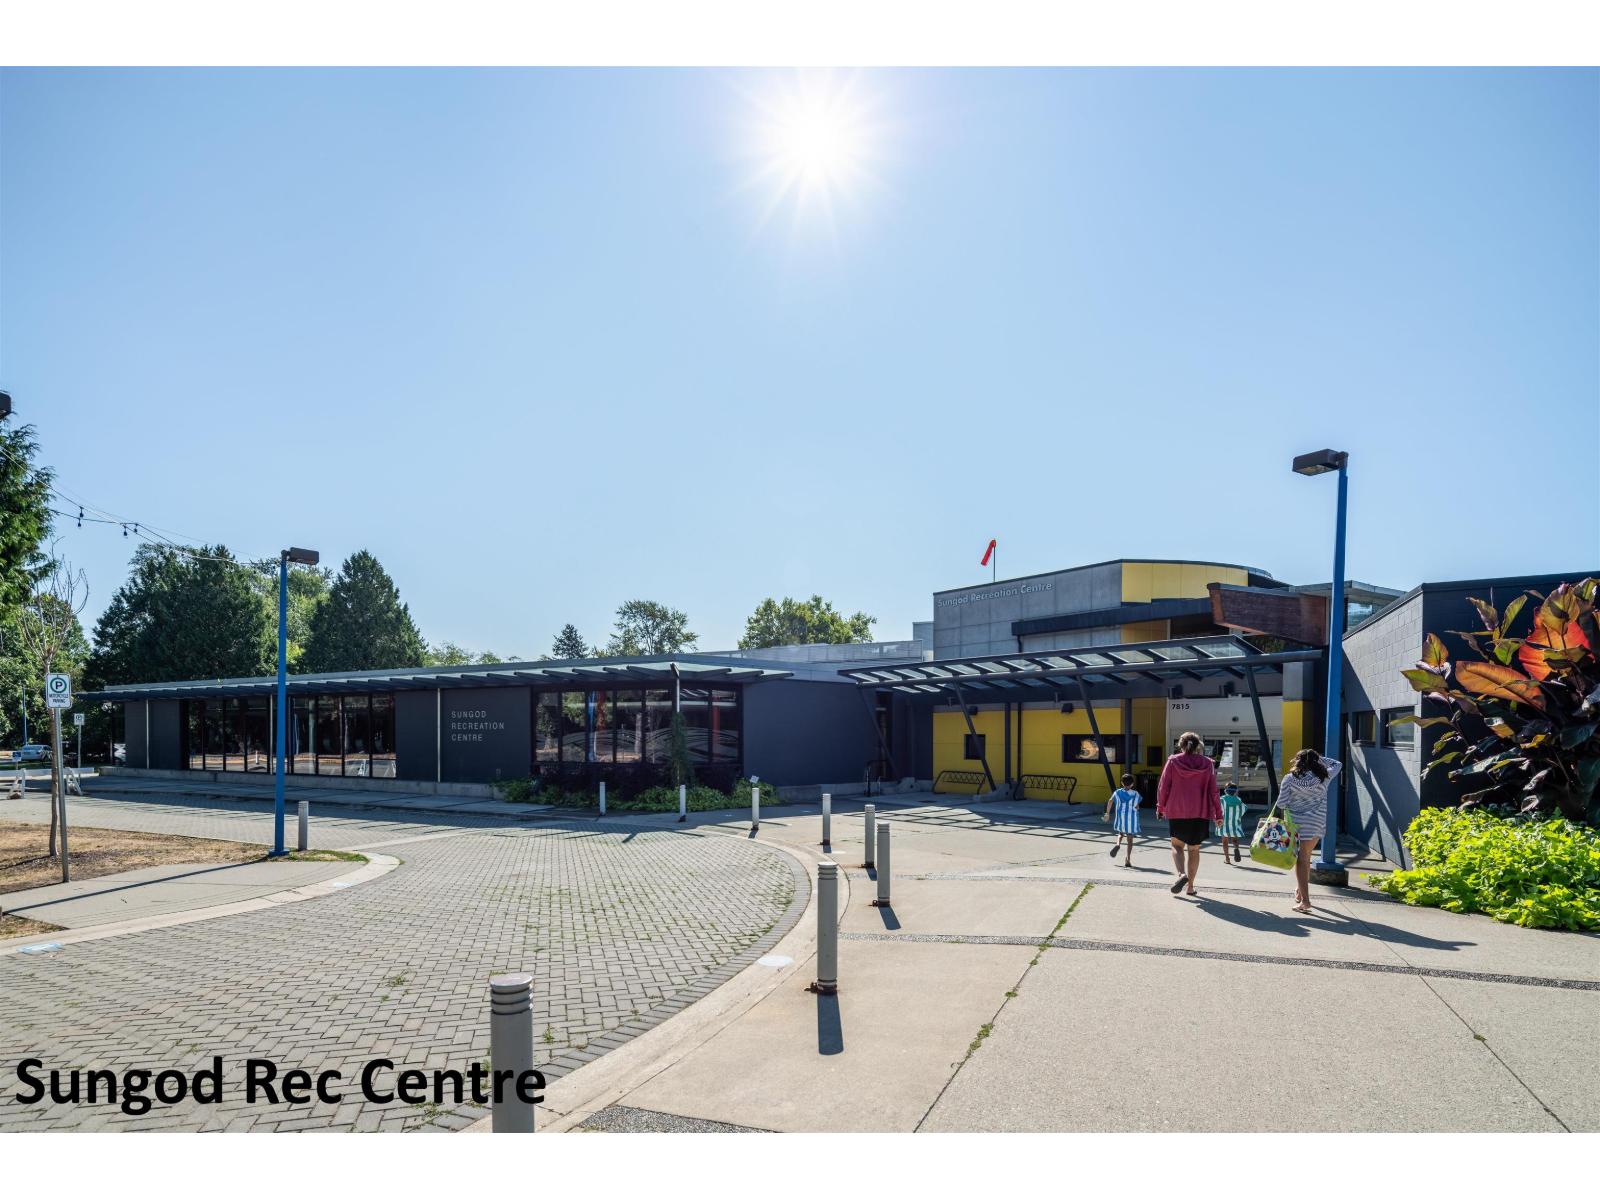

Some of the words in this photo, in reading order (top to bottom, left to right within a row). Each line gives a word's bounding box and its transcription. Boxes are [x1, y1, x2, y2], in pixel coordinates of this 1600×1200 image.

[938, 594, 968, 607] Sungod
[971, 588, 1018, 602] Recreation
[1020, 582, 1052, 594] Centre
[55, 681, 63, 690] P
[451, 710, 487, 718] SUNGOD
[451, 722, 505, 730] RECREATION
[451, 733, 483, 741] CENTRE
